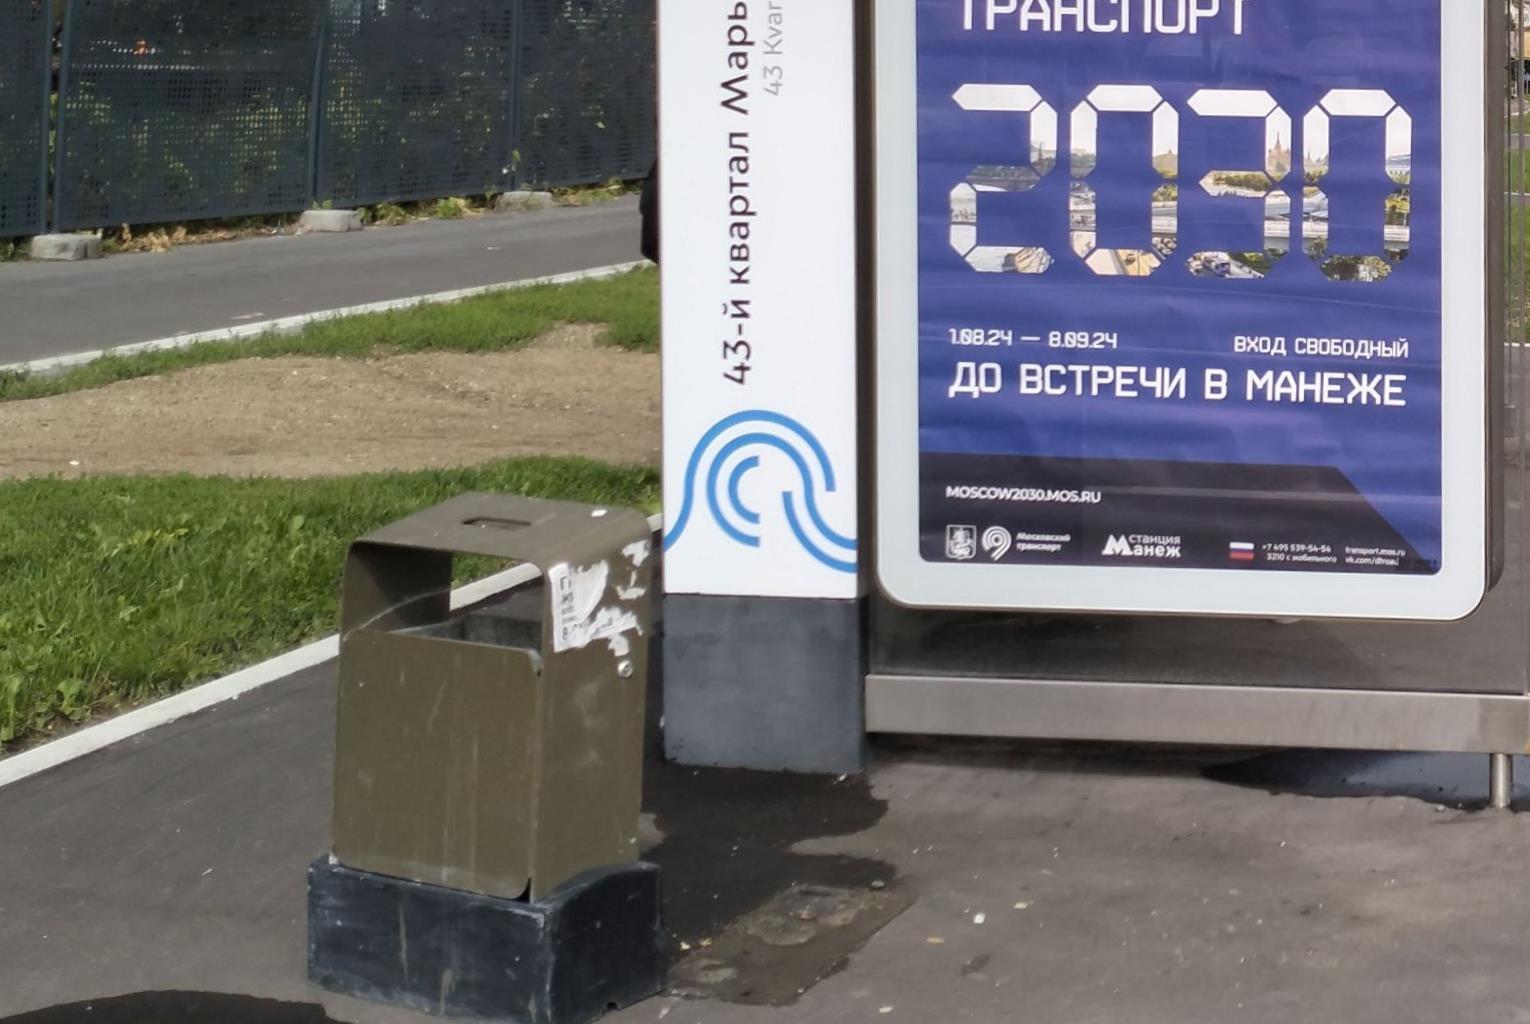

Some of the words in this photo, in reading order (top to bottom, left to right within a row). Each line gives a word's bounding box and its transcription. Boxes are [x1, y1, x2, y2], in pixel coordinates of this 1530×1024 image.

[763, 64, 784, 97] 43
[949, 83, 1413, 283] 2030
[728, 131, 757, 284] квартал
[722, 298, 752, 384] 43-й
[948, 328, 1013, 347] 1.08.24
[1048, 331, 1118, 349] 8.09.24
[1233, 336, 1287, 356] ВХОД
[1294, 337, 1409, 358] СВОБОДНЫЙ
[947, 362, 1003, 399] ДО
[1019, 363, 1187, 399] ВСТРЕЧИ
[1204, 368, 1228, 400] В
[1246, 369, 1407, 407] МАНЕЖЕ
[945, 485, 1101, 504] MOSCOW2030.MOS.RU
[1015, 531, 1071, 543] Московский
[1015, 542, 1063, 552] транспорт
[1128, 534, 1181, 545] станция
